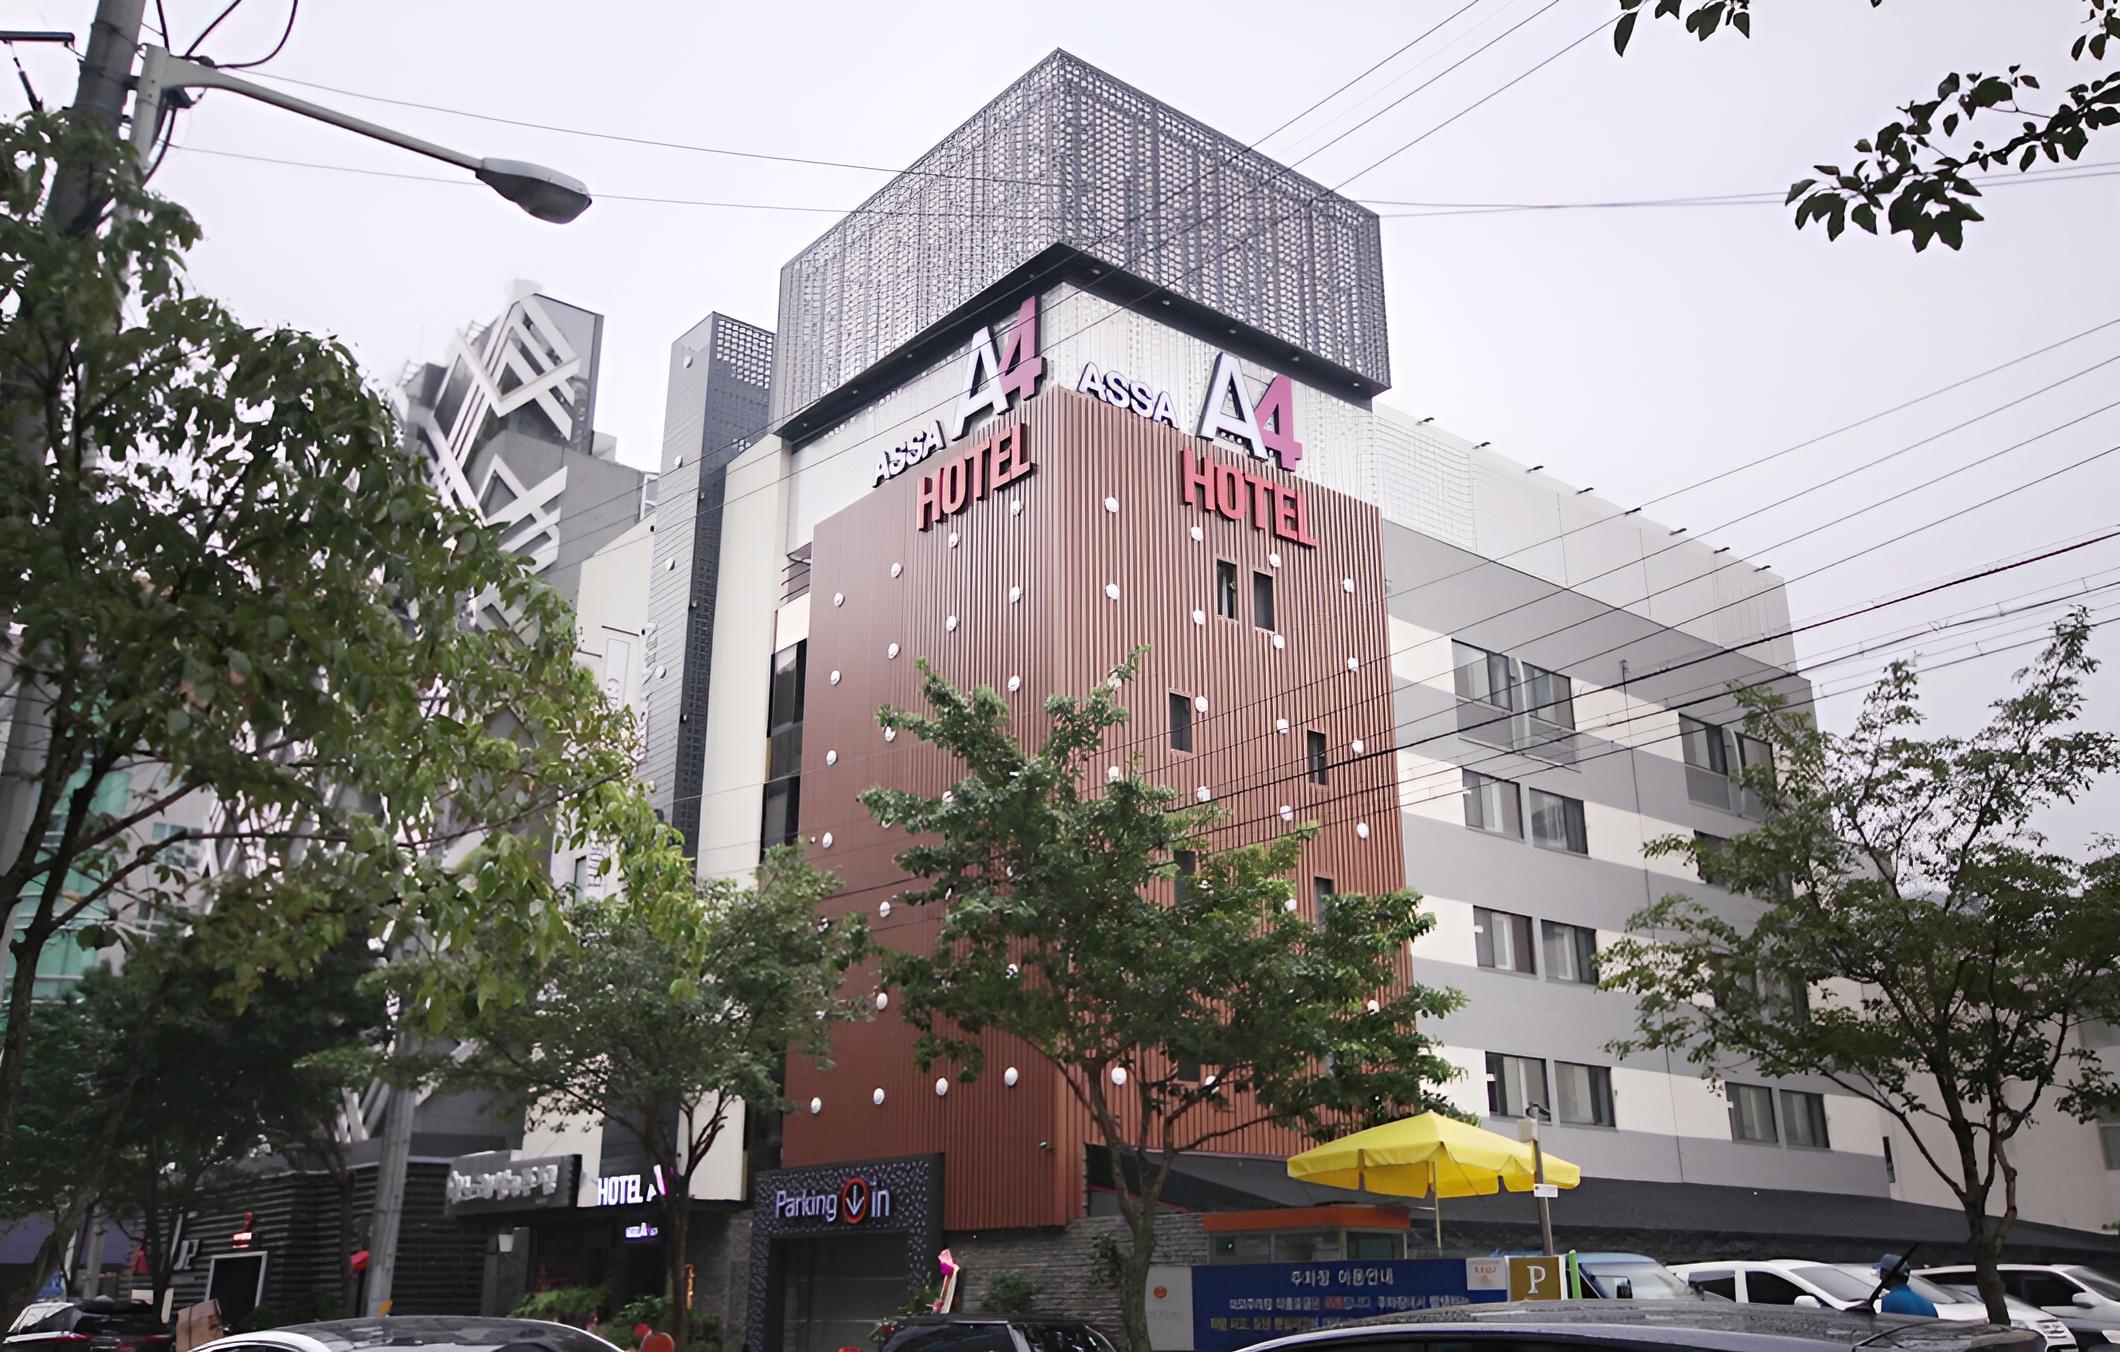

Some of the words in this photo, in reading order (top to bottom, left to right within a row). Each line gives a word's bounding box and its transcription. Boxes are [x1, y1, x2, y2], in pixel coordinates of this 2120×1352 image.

[872, 419, 946, 487] ASSA
[951, 295, 1044, 441] A4
[1077, 361, 1178, 428] ASSA
[1197, 351, 1303, 471] A4
[918, 422, 1034, 531] HOTEL
[1181, 449, 1317, 548] HOTEL
[597, 1174, 643, 1206] HOTEL
[775, 1189, 838, 1222] Parking
[870, 1178, 890, 1217] in
[1526, 1265, 1547, 1294] P
